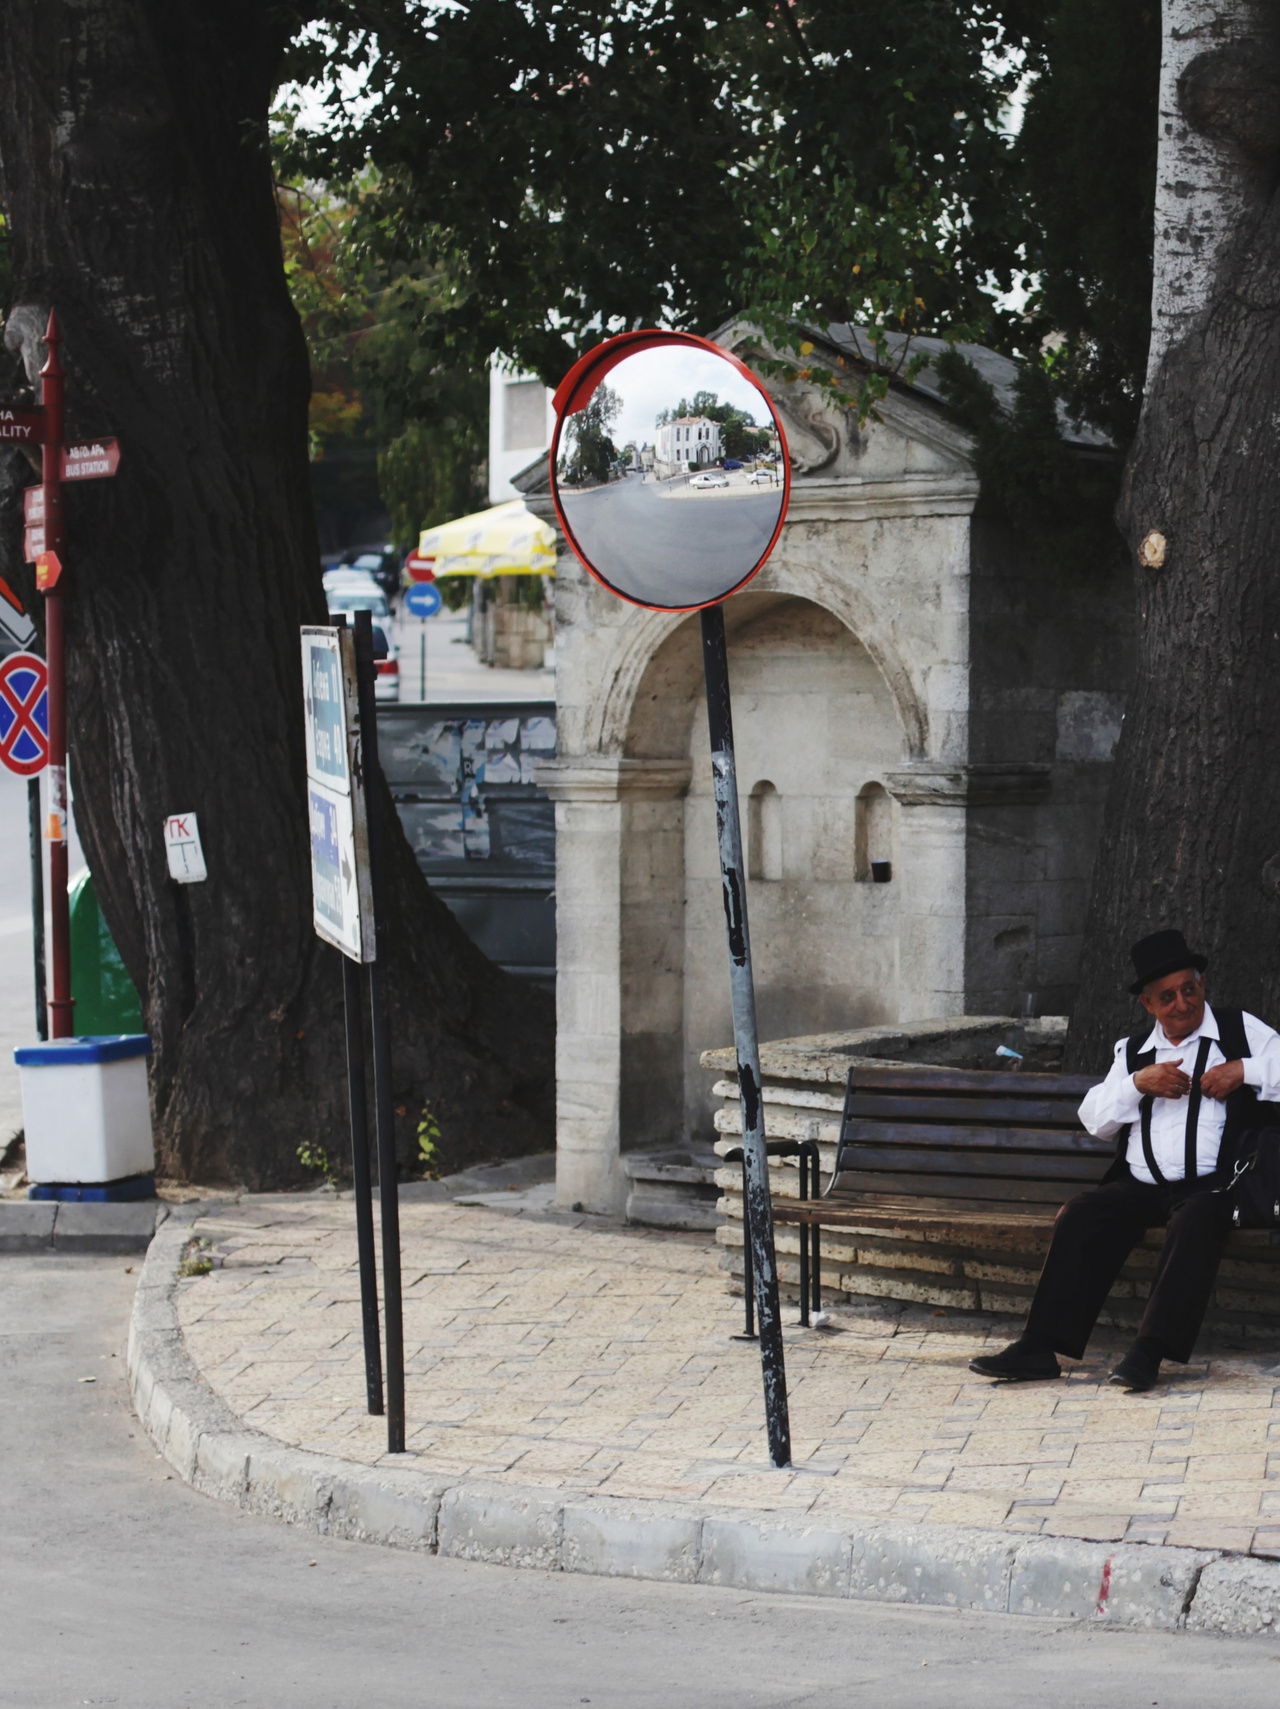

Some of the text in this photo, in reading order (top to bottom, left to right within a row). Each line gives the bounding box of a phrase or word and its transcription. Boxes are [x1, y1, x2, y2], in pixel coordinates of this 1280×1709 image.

[0, 425, 32, 438] LITY
[65, 460, 109, 477] BUS STATION
